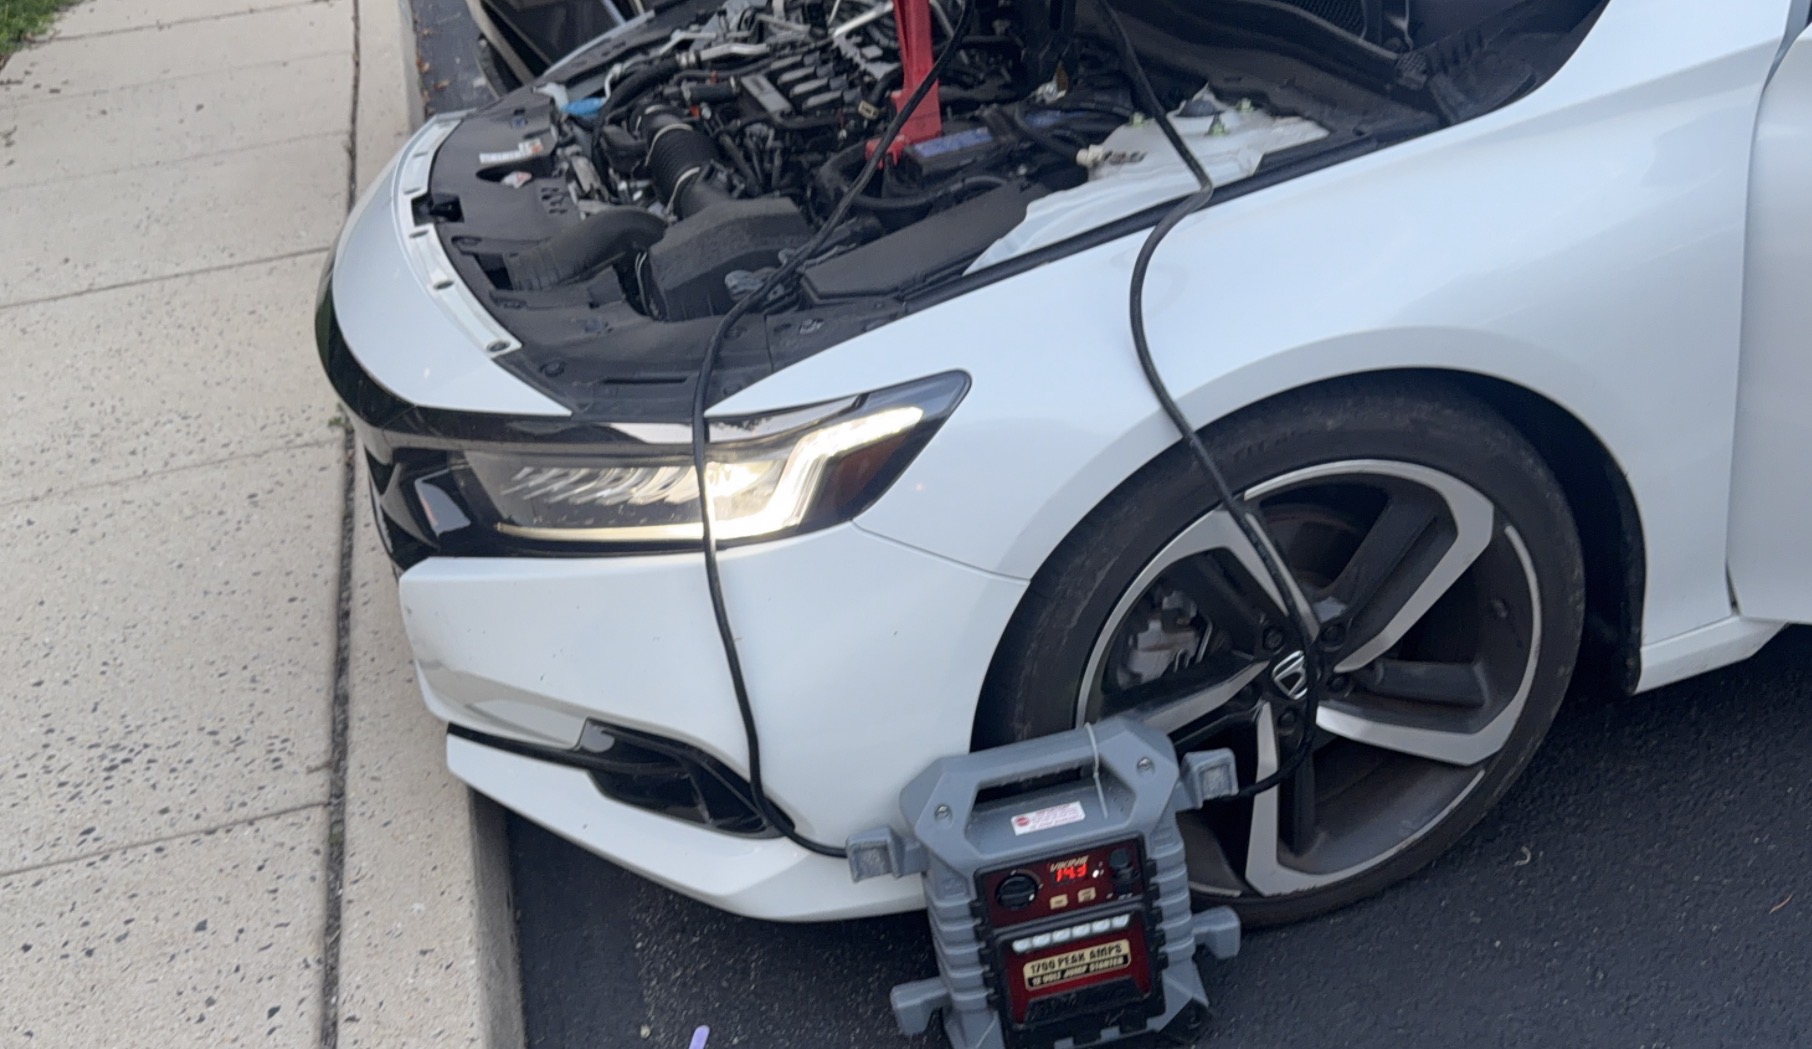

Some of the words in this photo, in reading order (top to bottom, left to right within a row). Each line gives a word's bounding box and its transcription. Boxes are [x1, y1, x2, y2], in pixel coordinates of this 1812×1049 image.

[1050, 855, 1089, 872] VIKING
[1030, 960, 1056, 974] 1700
[1057, 953, 1086, 968] PEAK
[1089, 943, 1122, 959] AMPS
